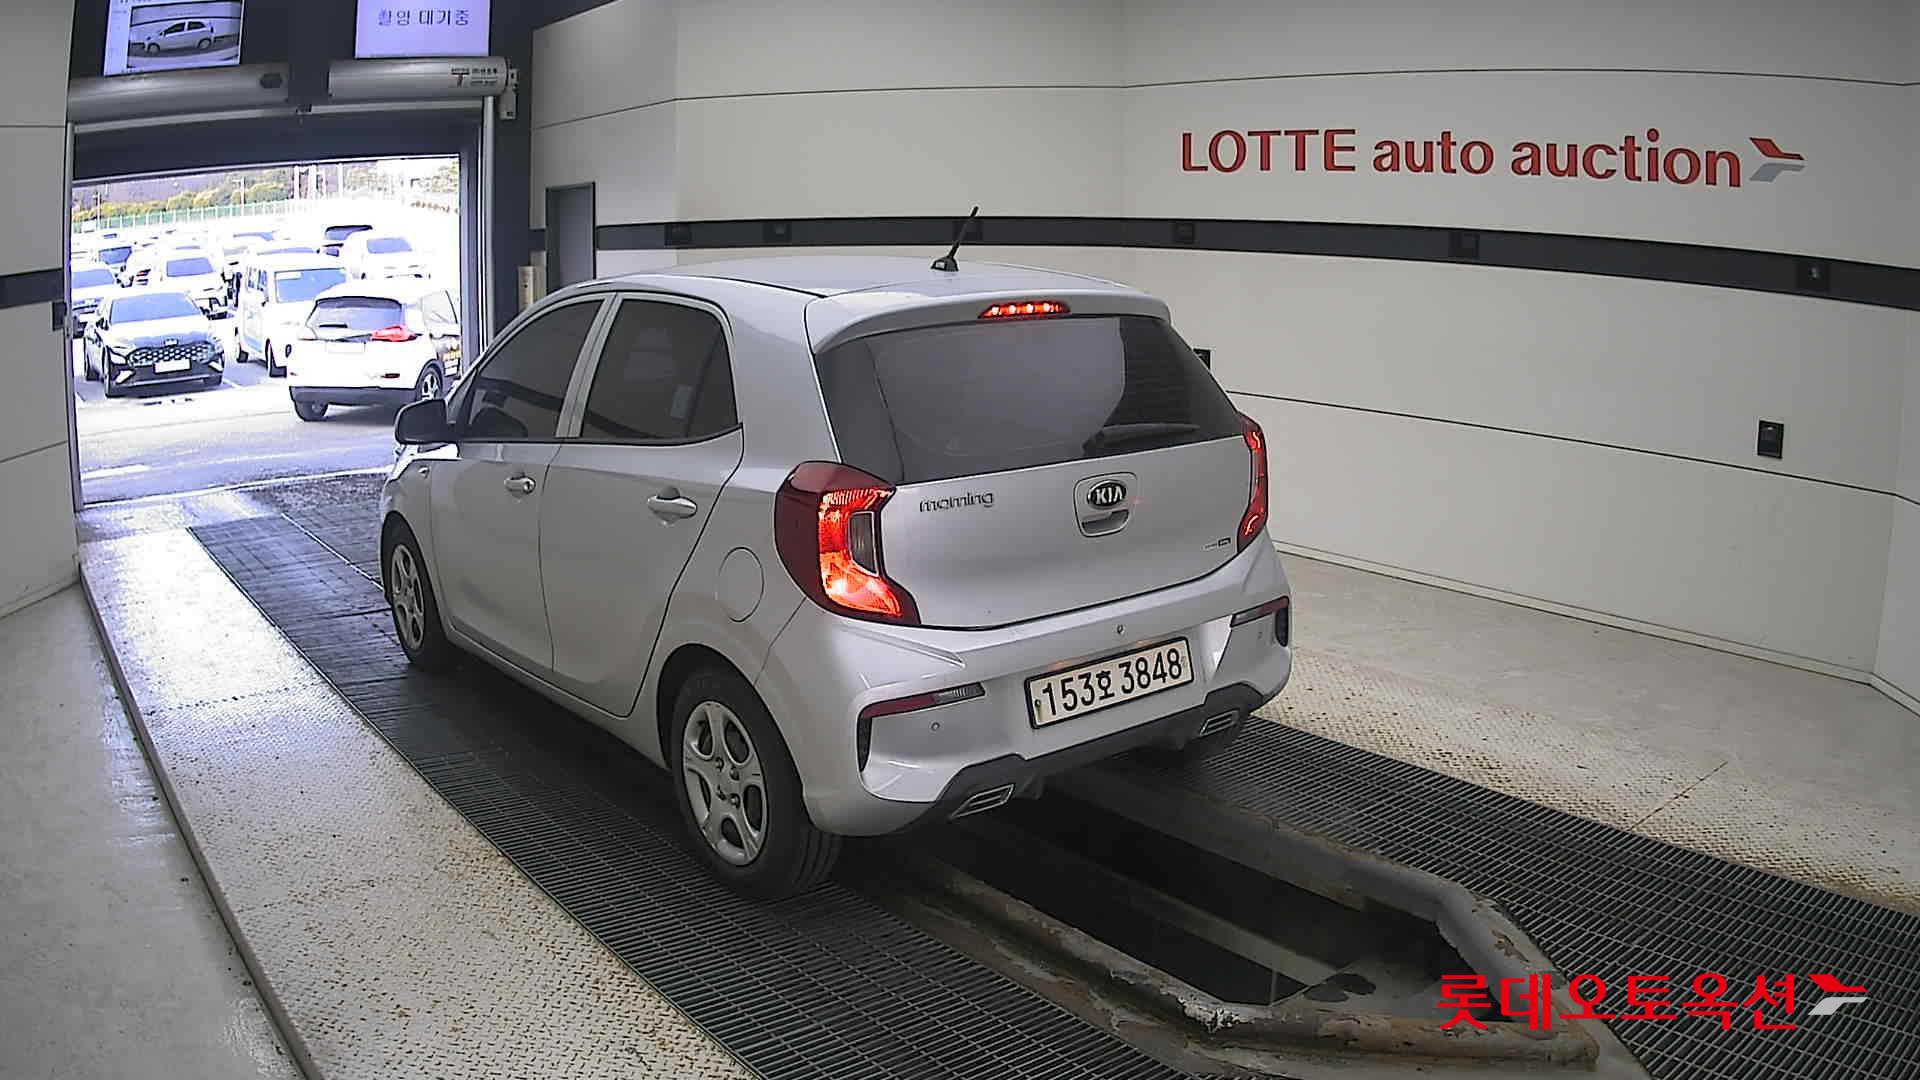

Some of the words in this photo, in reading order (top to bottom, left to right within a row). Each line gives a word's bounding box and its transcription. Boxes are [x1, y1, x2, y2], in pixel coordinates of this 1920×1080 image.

[1181, 128, 1356, 172] LOTTE
[1372, 130, 1494, 175] auto
[1511, 128, 1741, 187] auction
[920, 491, 993, 512] morning
[1118, 648, 1182, 694] 3848
